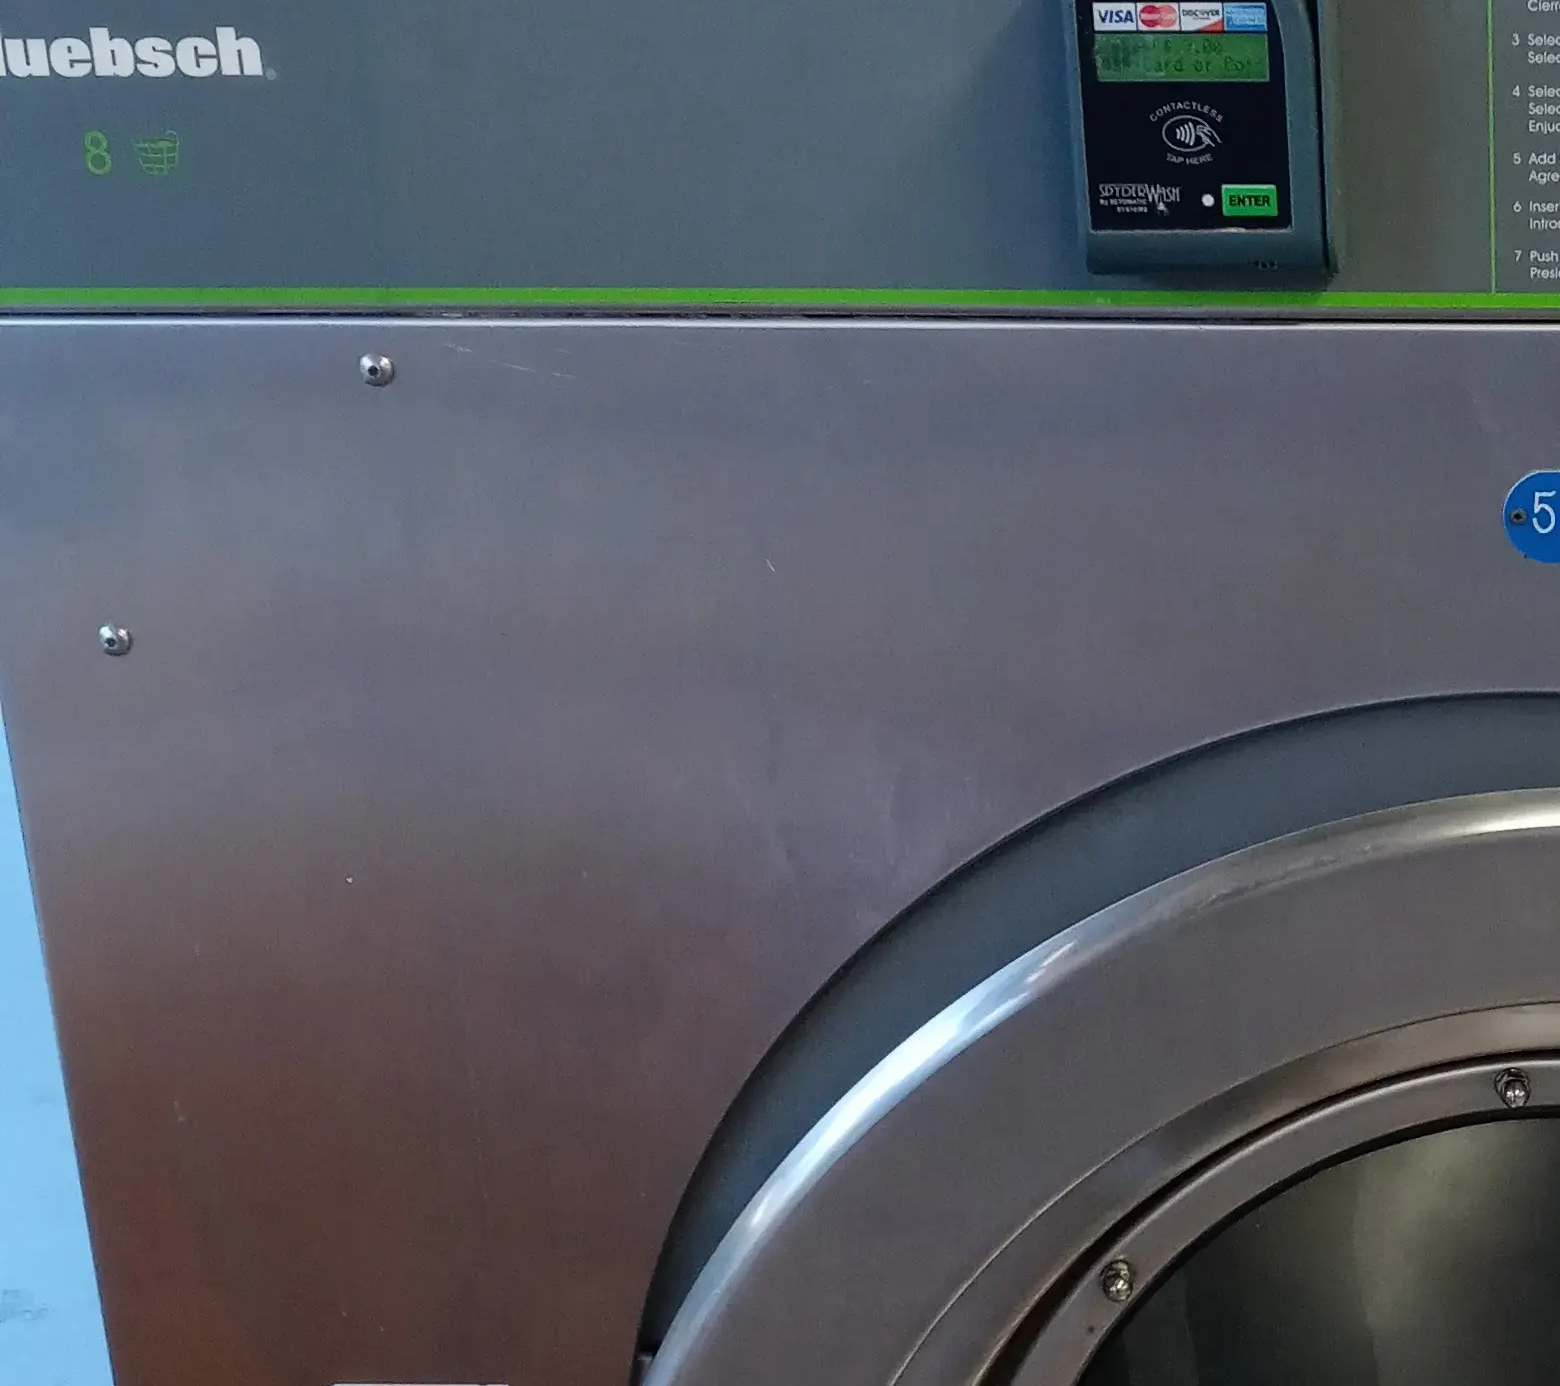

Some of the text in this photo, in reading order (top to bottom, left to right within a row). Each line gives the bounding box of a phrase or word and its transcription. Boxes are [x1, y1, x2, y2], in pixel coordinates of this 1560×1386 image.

[1099, 9, 1134, 24] VISA
[1512, 34, 1520, 46] 3
[0, 26, 263, 78] uebsch
[1512, 86, 1520, 98] 4
[1149, 100, 1223, 123] CONTACTLESS
[84, 131, 112, 175] 8
[1166, 153, 1214, 165] TAP HERE
[1513, 153, 1521, 165] 5
[1528, 153, 1556, 165] Add
[1228, 194, 1271, 207] ENTER
[1513, 201, 1521, 212] 6
[1514, 250, 1521, 261] 7
[1530, 250, 1559, 262] Push
